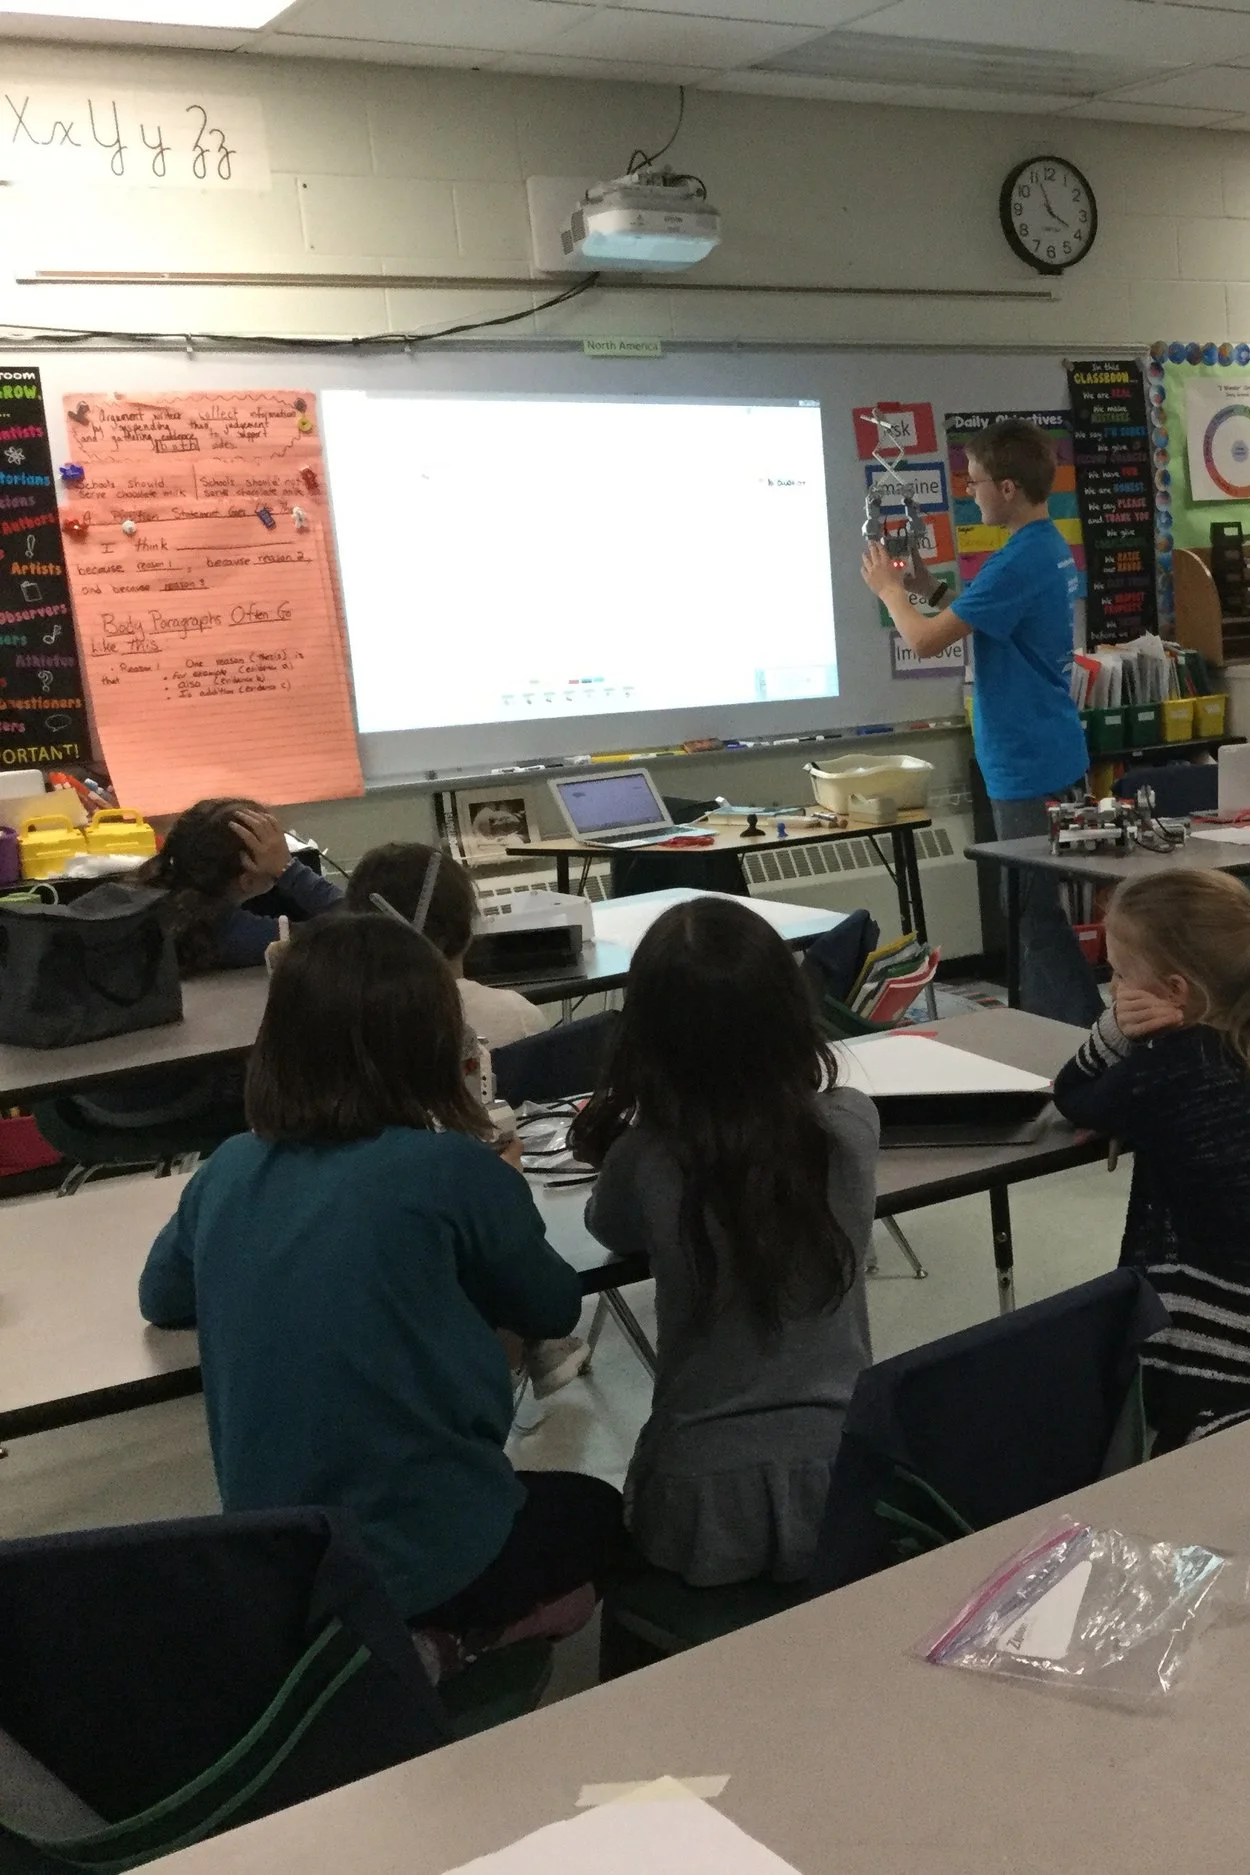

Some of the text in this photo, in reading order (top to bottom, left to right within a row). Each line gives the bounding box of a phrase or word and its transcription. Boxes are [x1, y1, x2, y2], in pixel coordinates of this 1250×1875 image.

[1030, 171, 1038, 184] 11
[1044, 168, 1056, 181] 12
[1018, 185, 1030, 198] 10
[1072, 188, 1080, 202] 2
[1014, 203, 1022, 216] 9
[1079, 210, 1087, 223] 3
[1020, 223, 1028, 237] 8
[1074, 229, 1081, 240] 4
[1032, 239, 1040, 253] 7
[1047, 246, 1055, 258] 6
[1063, 241, 1071, 254] 5
[587, 340, 658, 351] North America
[955, 416, 989, 428] Daily
[101, 538, 168, 554] I think
[11, 562, 62, 576] Artists
[101, 613, 145, 640] Body
[148, 610, 221, 639] Paragraphs
[277, 600, 292, 620] Go
[0, 744, 79, 764] ORTANT!
